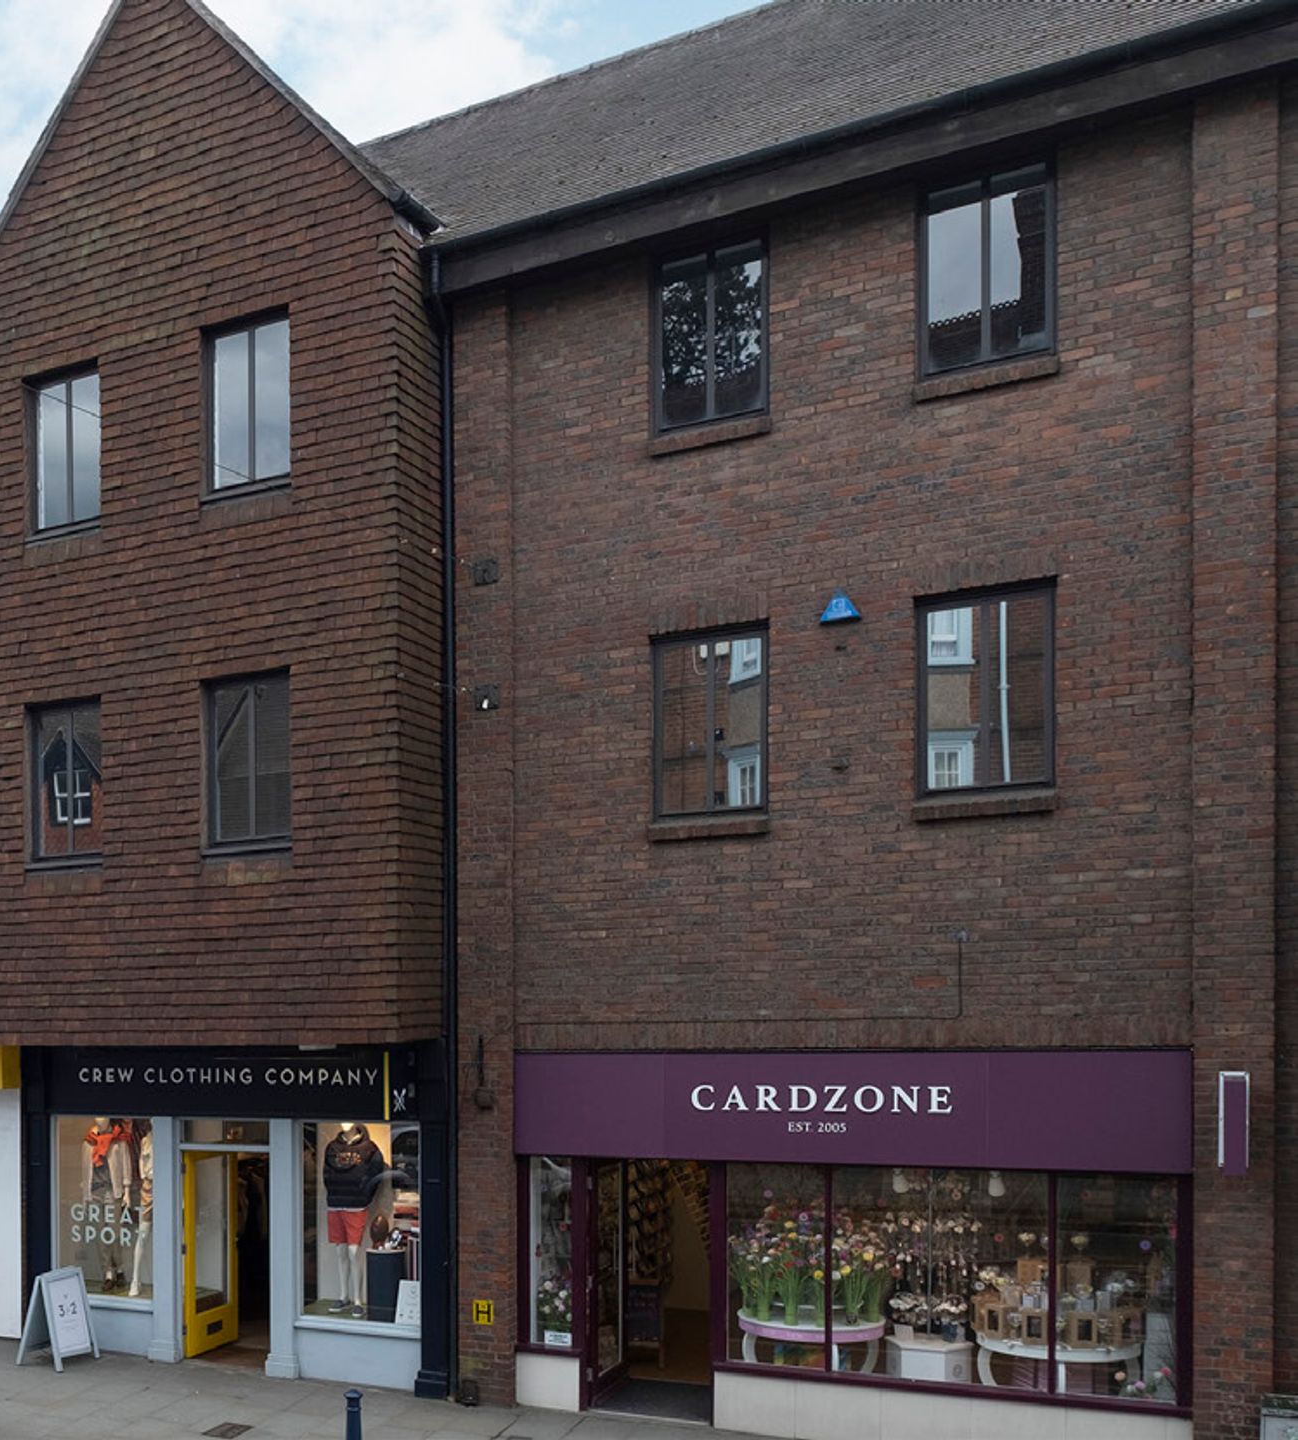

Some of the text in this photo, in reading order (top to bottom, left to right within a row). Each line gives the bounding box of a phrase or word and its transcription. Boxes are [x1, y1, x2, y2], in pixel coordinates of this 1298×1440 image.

[78, 1067, 379, 1086] CREW CLOTHING COMPANY
[690, 1084, 953, 1114] CARDZONE
[817, 1122, 847, 1133] 2005
[70, 1203, 146, 1225] GREAT
[476, 1303, 492, 1323] H
